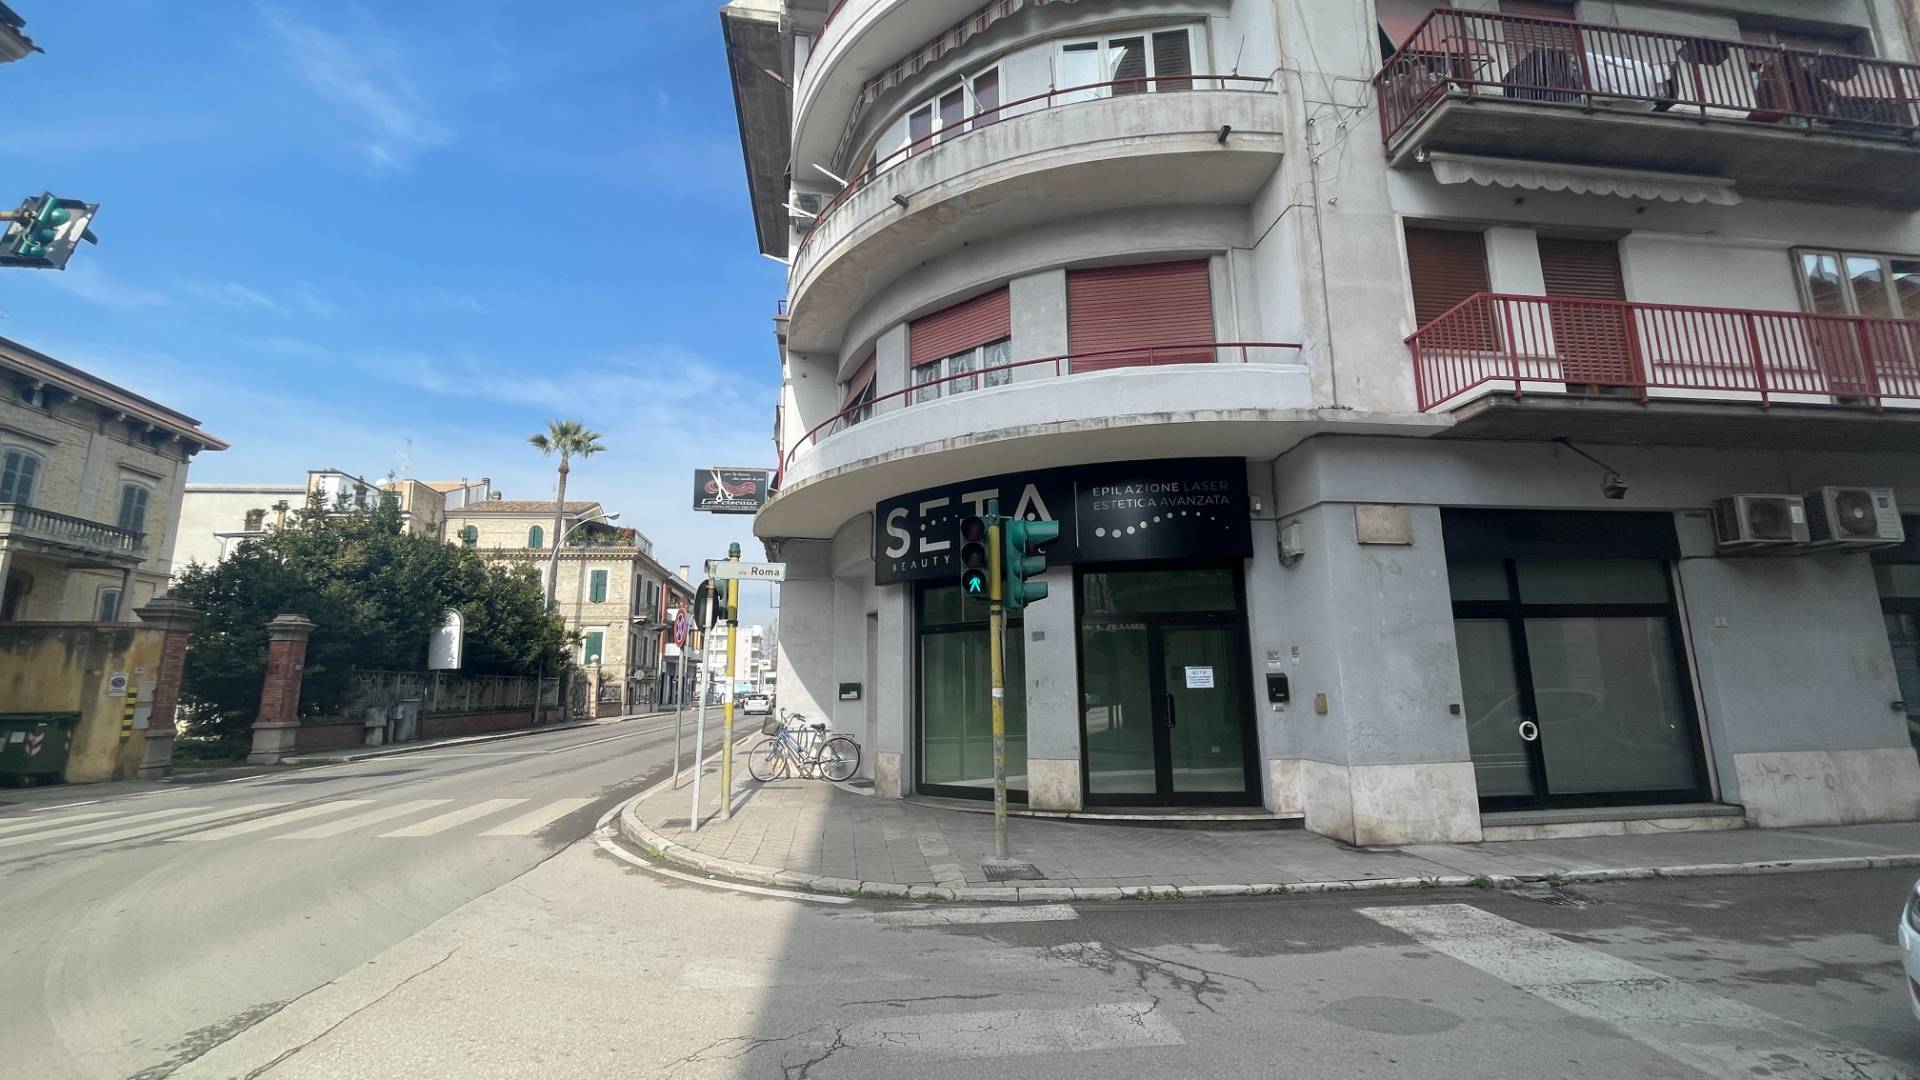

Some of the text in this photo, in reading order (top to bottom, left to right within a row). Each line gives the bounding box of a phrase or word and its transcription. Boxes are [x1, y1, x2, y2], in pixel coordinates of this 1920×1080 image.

[1092, 480, 1228, 497] EPILAZIONE LASER
[1093, 494, 1231, 511] ESTETICA AVANZATA
[751, 566, 780, 576] Roma
[892, 555, 950, 572] BEAUTY
